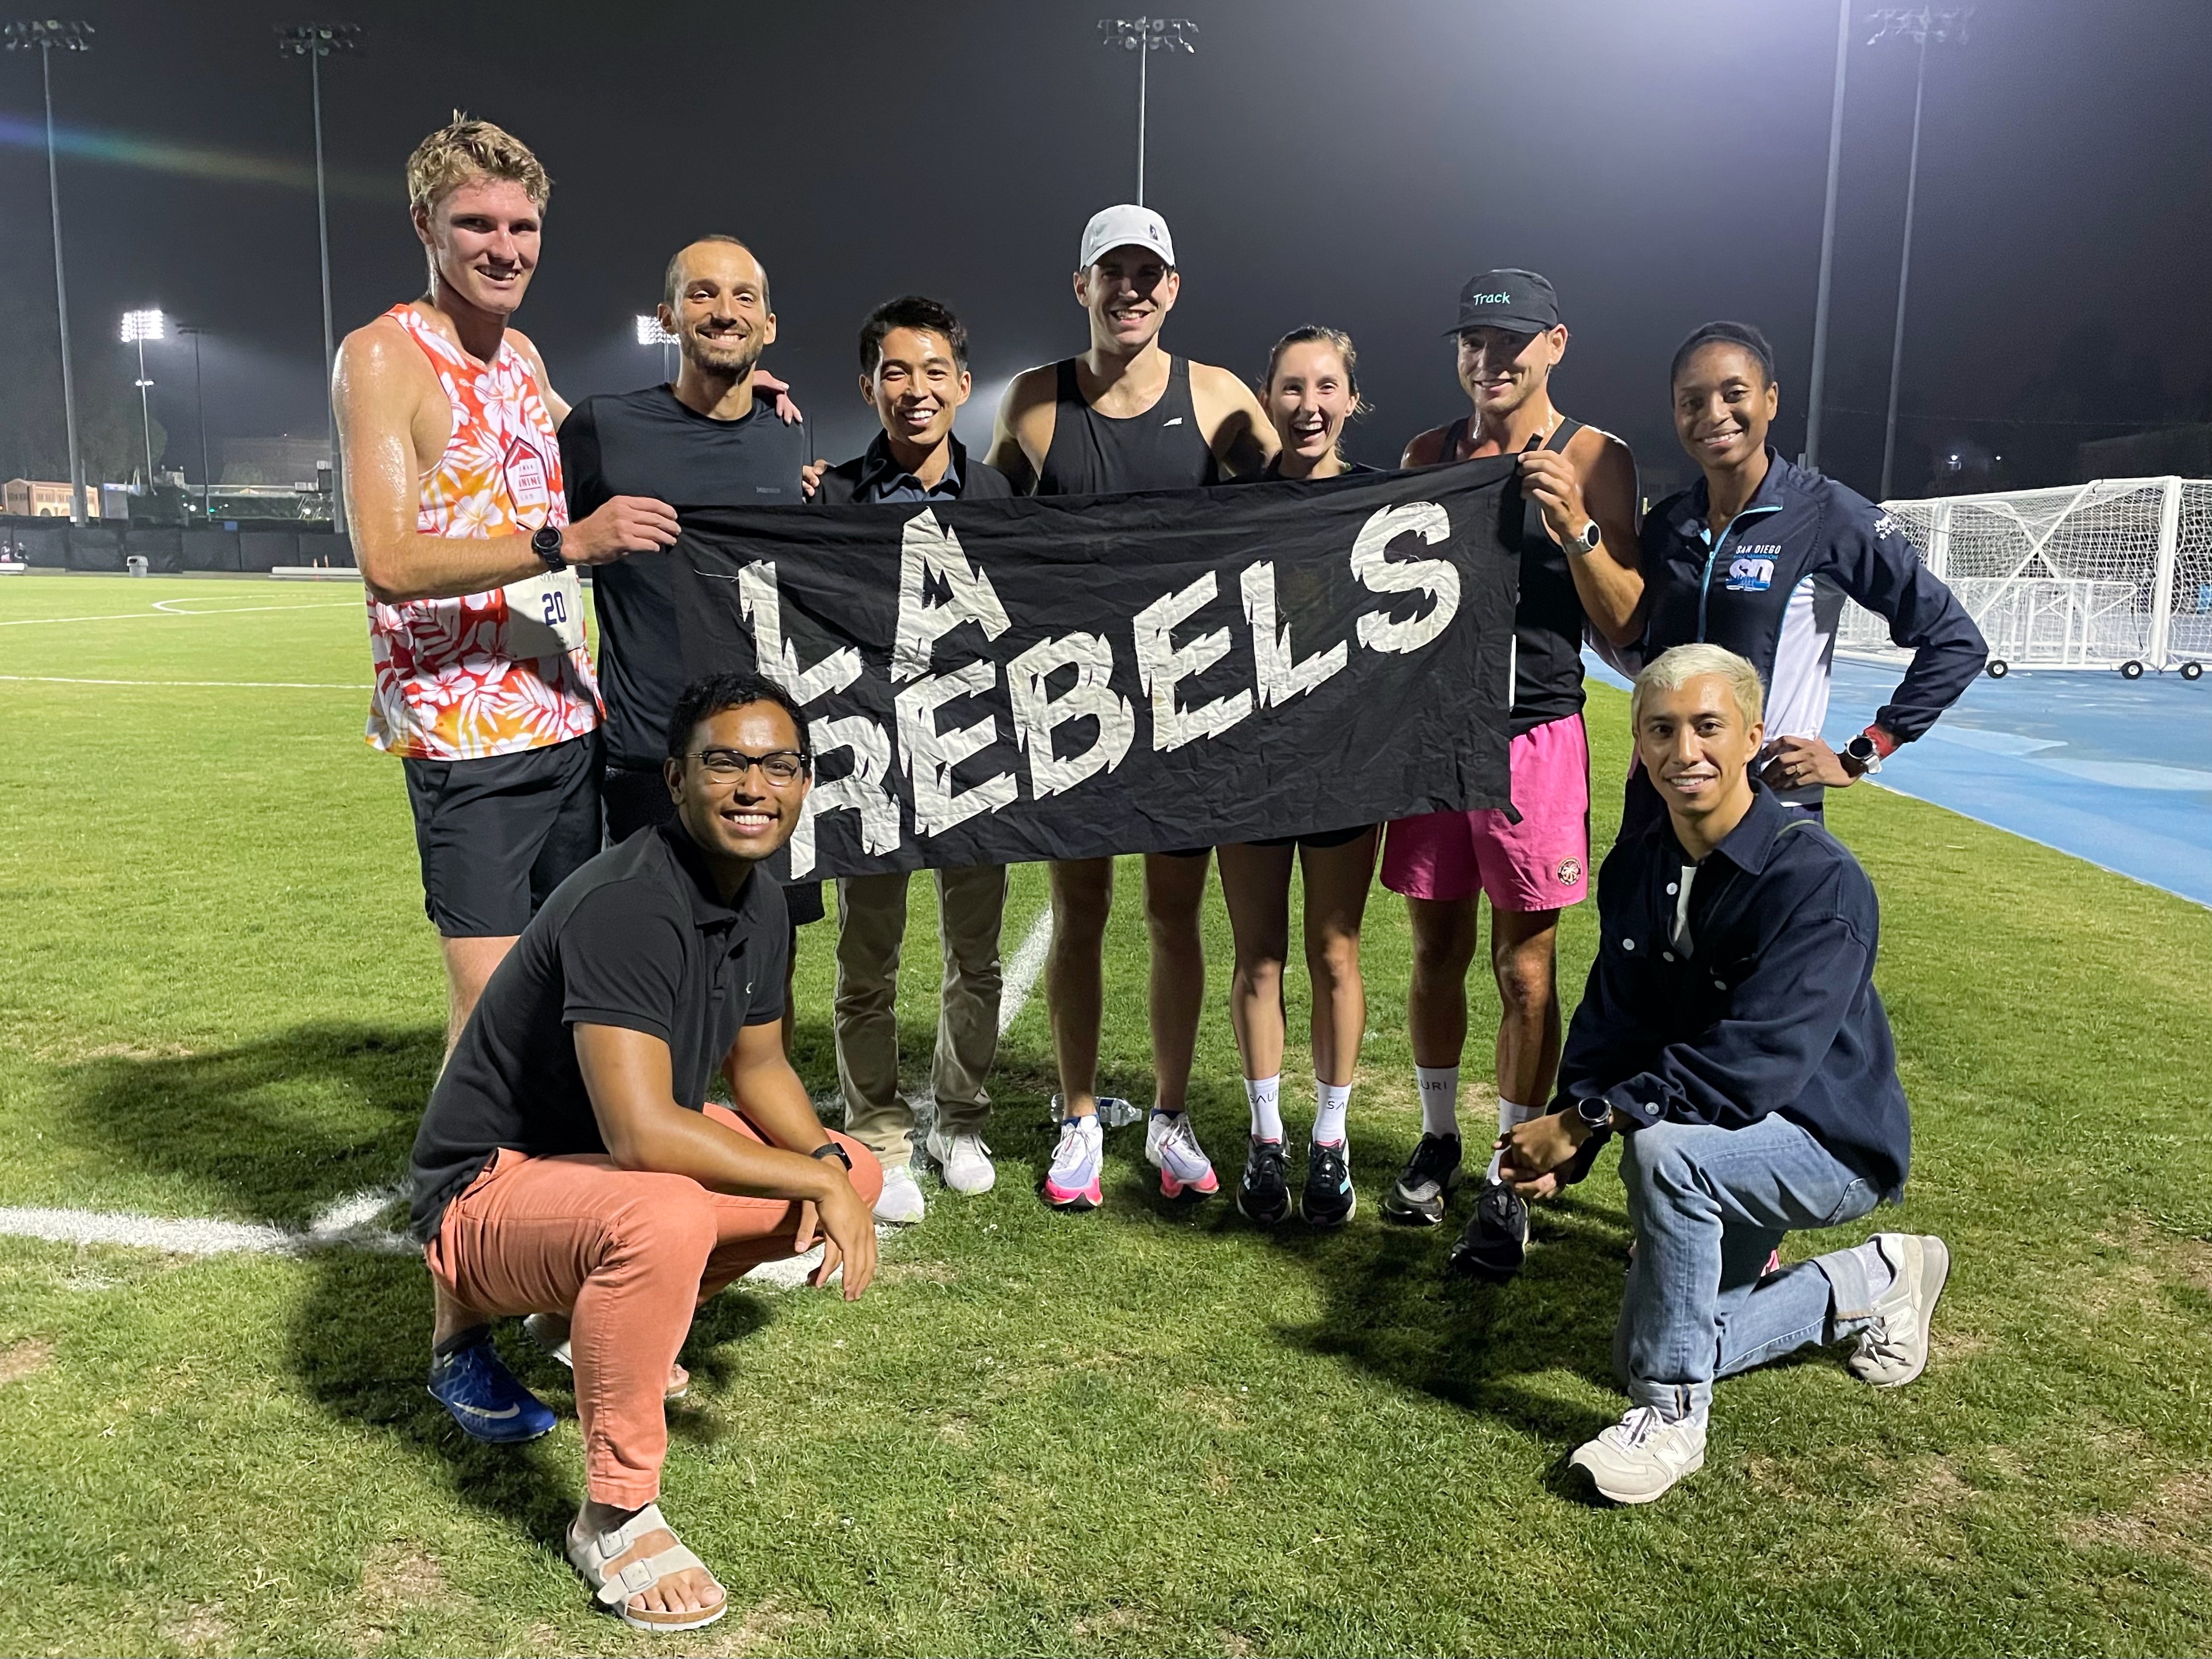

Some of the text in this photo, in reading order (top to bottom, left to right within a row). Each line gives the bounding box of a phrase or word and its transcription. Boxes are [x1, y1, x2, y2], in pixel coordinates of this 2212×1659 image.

[1473, 291, 1511, 305] Track
[1736, 545, 1781, 554] SAN DIEGO
[542, 591, 567, 627] 20
[737, 506, 1011, 705] LA
[788, 500, 1462, 881] REBELS
[1420, 1079, 1447, 1091] URI
